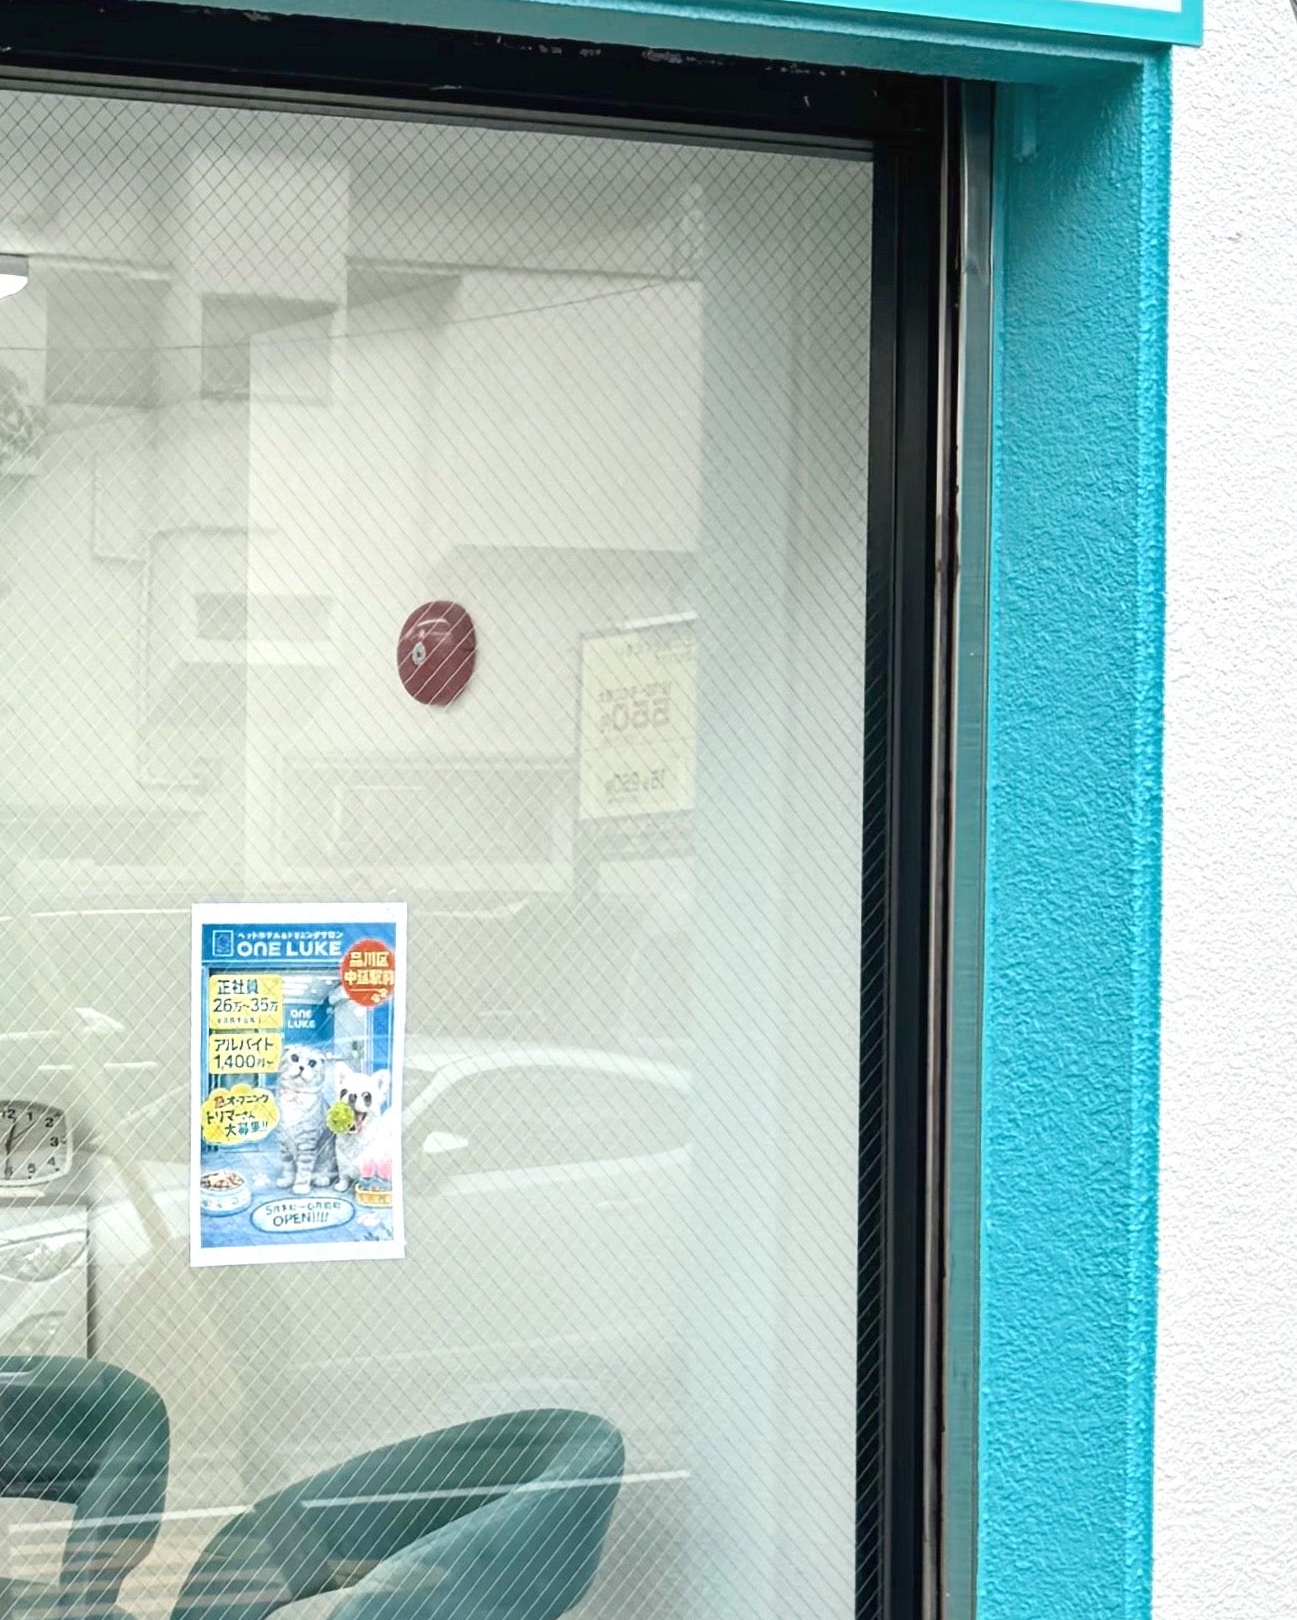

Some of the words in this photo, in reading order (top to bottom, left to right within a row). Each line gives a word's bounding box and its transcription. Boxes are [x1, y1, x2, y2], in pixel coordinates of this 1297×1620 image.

[237, 941, 282, 957] ONE
[285, 941, 342, 956] LUKE
[349, 951, 390, 967] 品川区
[217, 979, 259, 995] 正社員
[214, 1037, 274, 1052] アルバイト
[50, 1136, 60, 1147] 3
